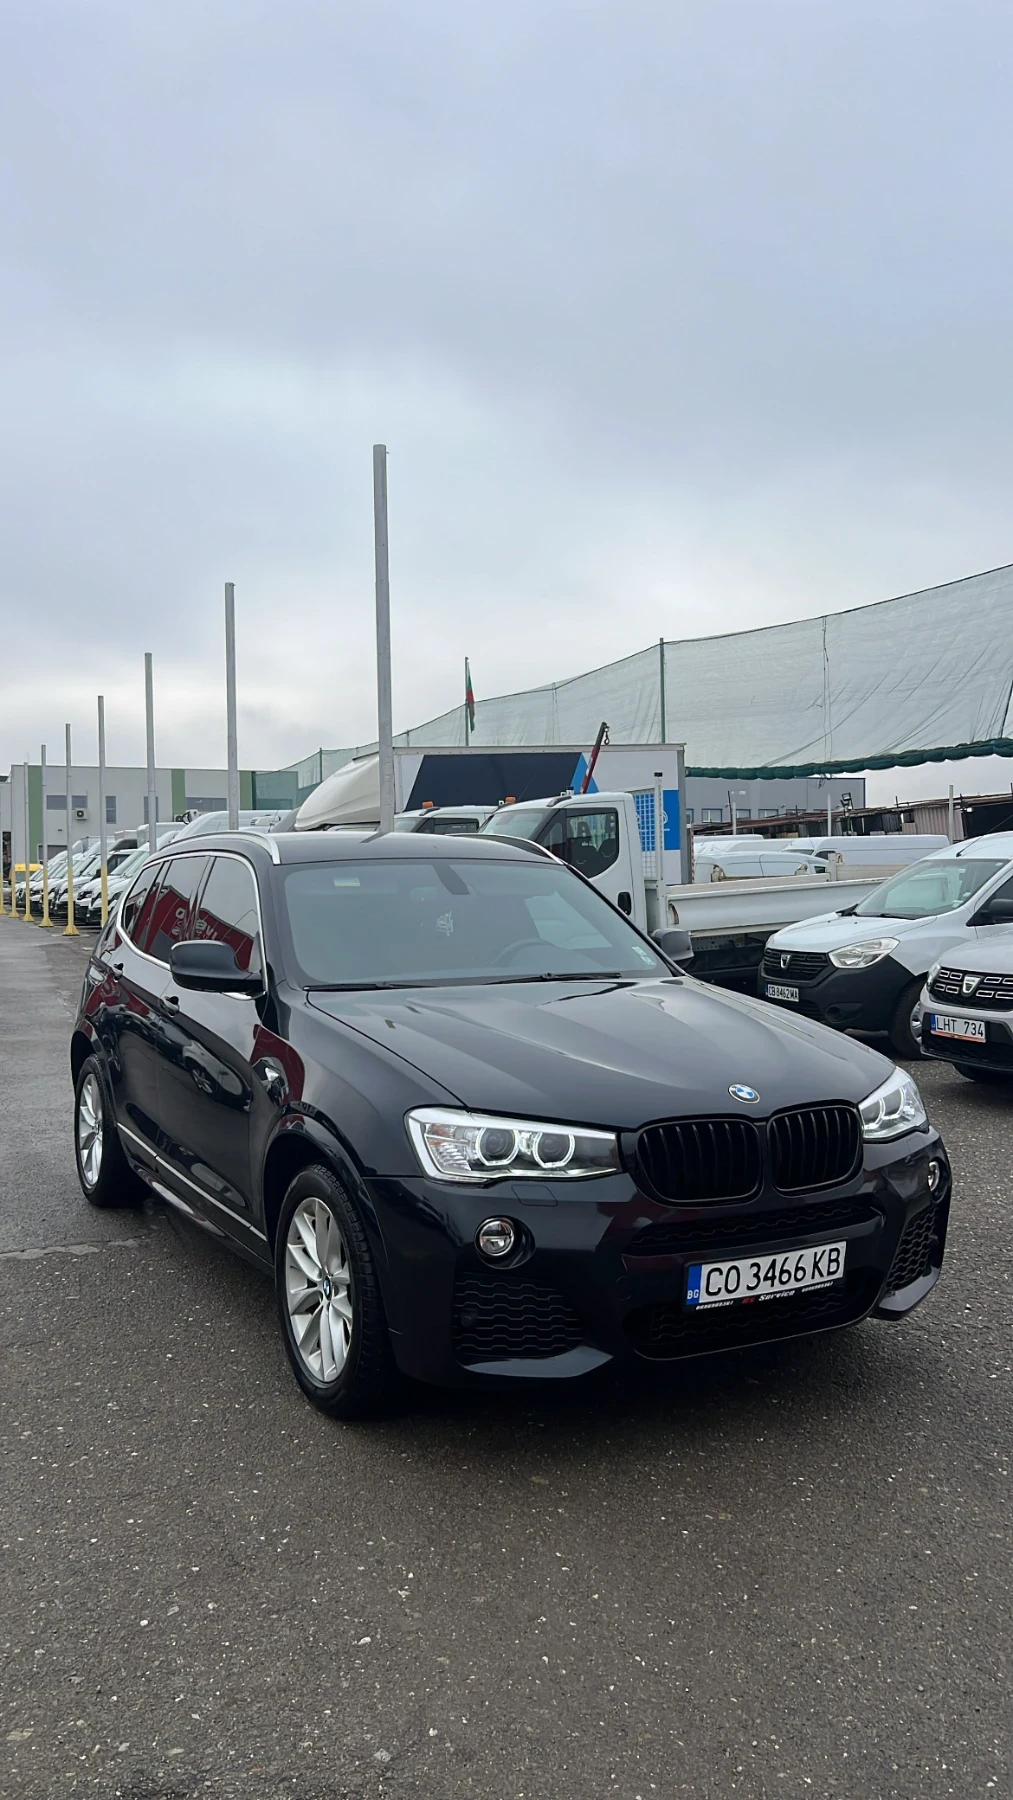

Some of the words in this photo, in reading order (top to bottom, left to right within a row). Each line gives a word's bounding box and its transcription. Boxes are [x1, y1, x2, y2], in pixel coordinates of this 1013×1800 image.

[936, 1016, 957, 1032] LHT
[964, 1021, 983, 1037] 734
[746, 1254, 806, 1291] 3466
[687, 1289, 699, 1299] BG
[758, 1290, 795, 1301] Service
